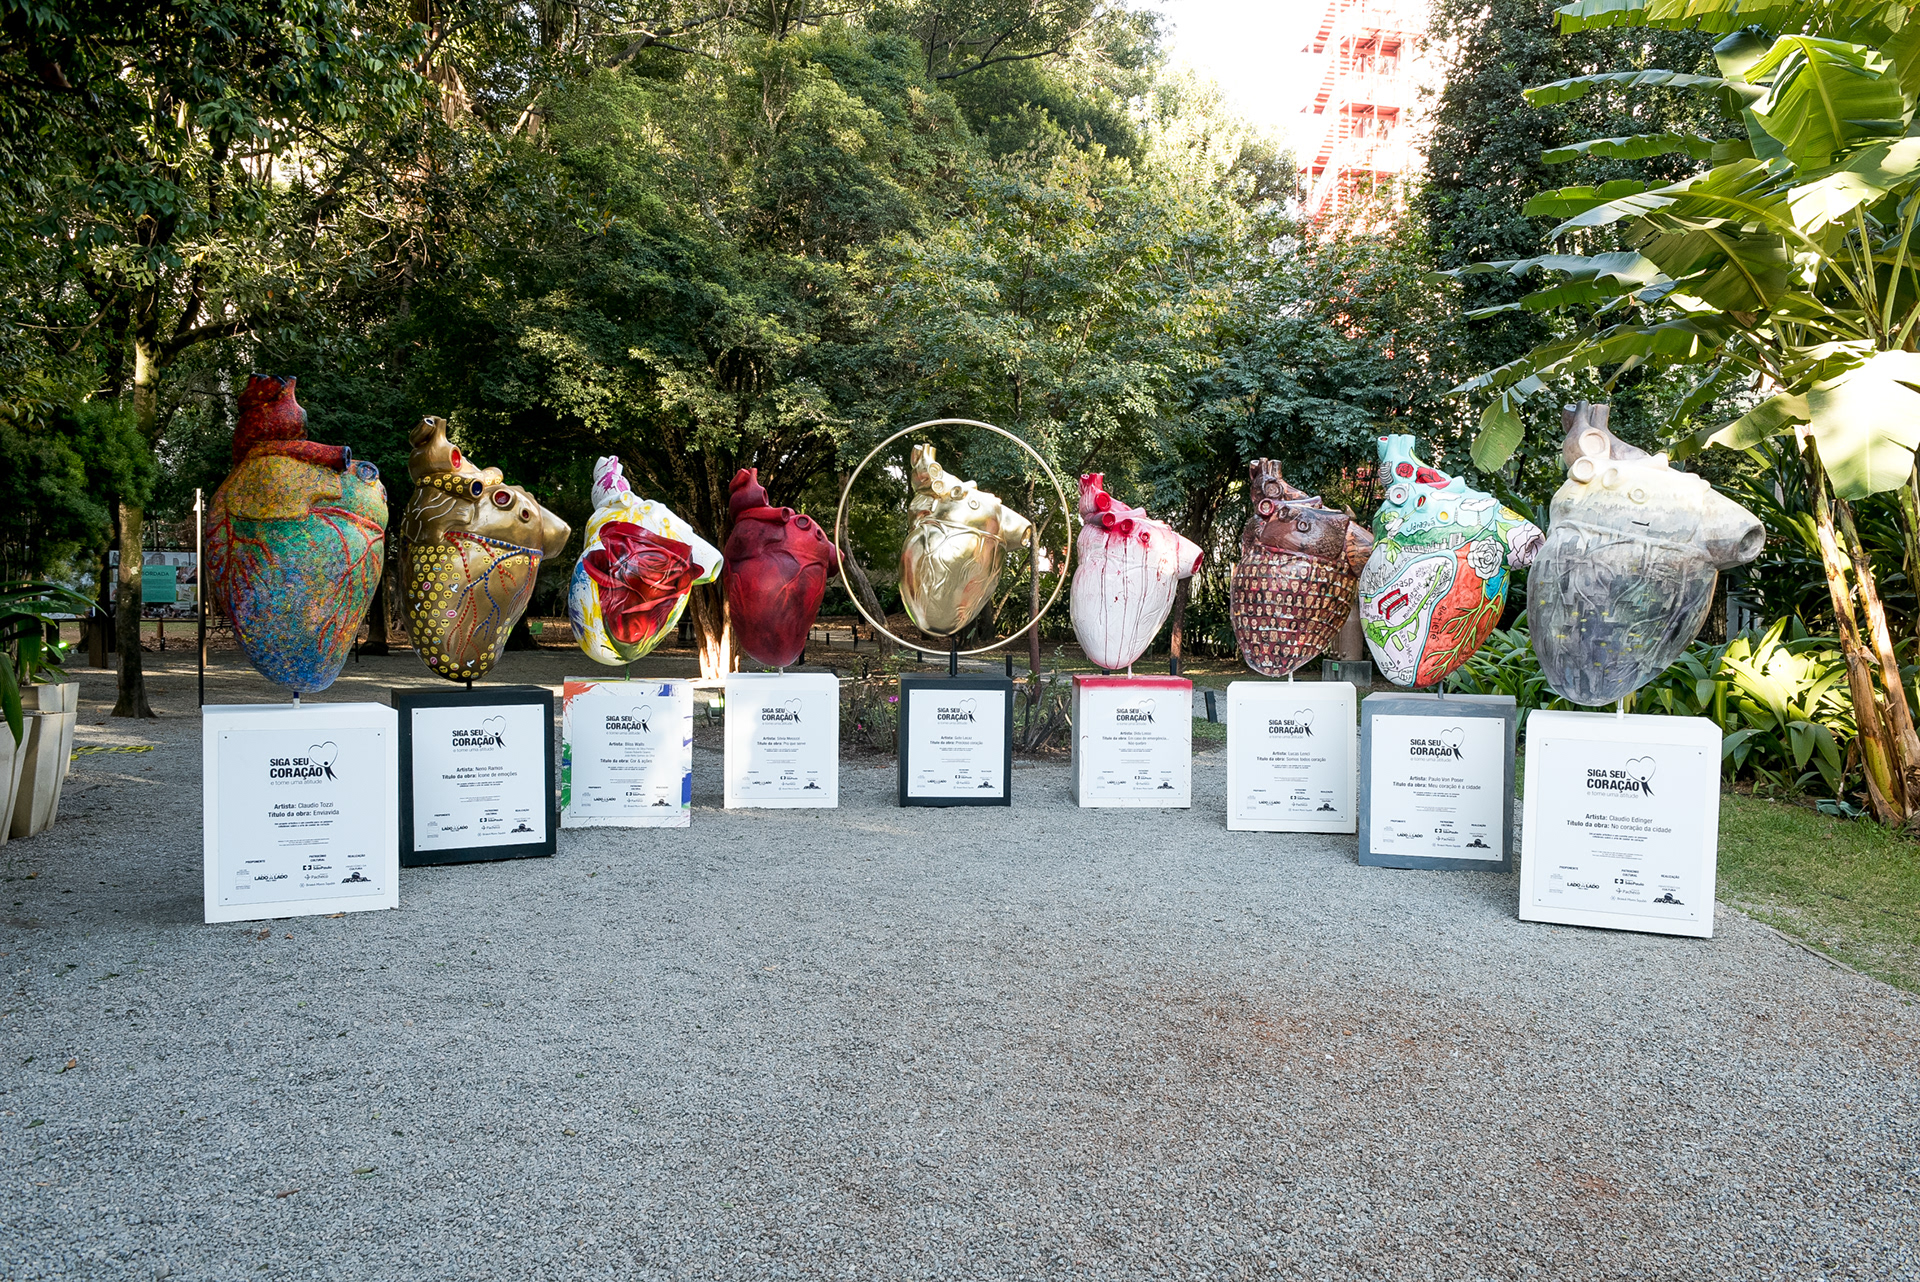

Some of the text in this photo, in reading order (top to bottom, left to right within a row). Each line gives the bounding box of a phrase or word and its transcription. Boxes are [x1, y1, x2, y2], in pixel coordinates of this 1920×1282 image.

[762, 713, 793, 722] CORAÇÃO
[938, 712, 968, 721] CORAÇÃO
[1116, 713, 1147, 722] CORAÇÃO
[606, 721, 641, 731] CORAÇÃO
[1268, 725, 1304, 736] CORAÇÃO
[452, 735, 494, 748] CORAÇÃO
[1410, 746, 1452, 758] CORAÇÃO
[270, 765, 323, 780] CORAÇÃO
[1587, 769, 1626, 778] SIGA SEU
[1587, 778, 1639, 793] CORAÇÃO
